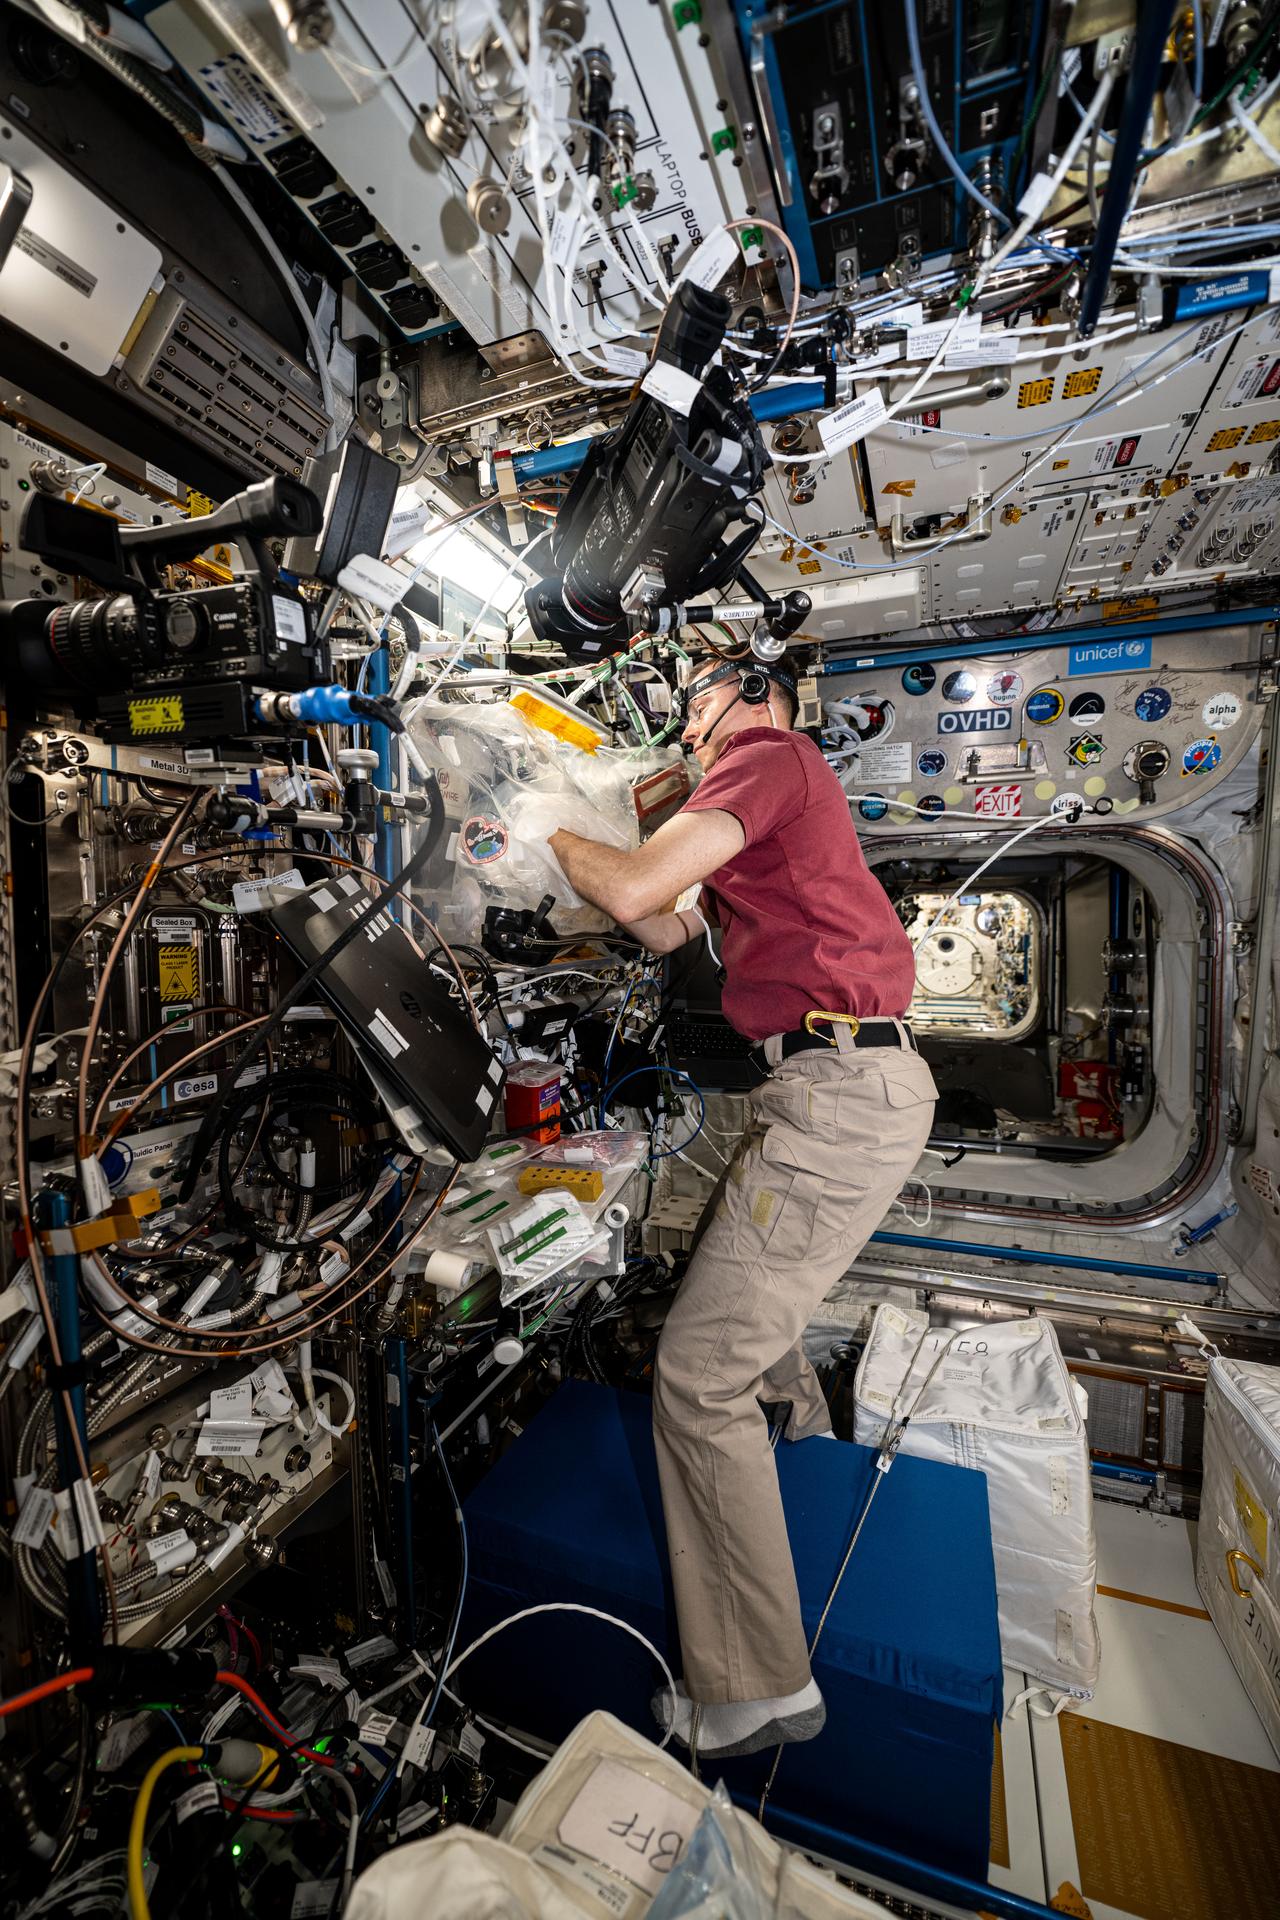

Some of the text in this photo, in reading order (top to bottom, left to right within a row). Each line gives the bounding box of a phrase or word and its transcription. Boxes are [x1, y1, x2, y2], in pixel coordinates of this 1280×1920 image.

[234, 68, 280, 124] ATTENTION
[656, 142, 686, 198] LAPTOP
[17, 434, 66, 464] PANEL B
[213, 612, 237, 621] Canon
[1076, 642, 1124, 662] unicef
[1209, 704, 1236, 715] alpha
[940, 710, 1011, 733] OVHD
[1185, 740, 1213, 756] principia
[151, 760, 189, 775] Metal 3D
[982, 794, 1014, 812] EXIT
[1058, 800, 1078, 808] iriss
[193, 1080, 214, 1092] esa
[133, 1142, 173, 1158] luidic Panel
[607, 1813, 683, 1874] BFF
